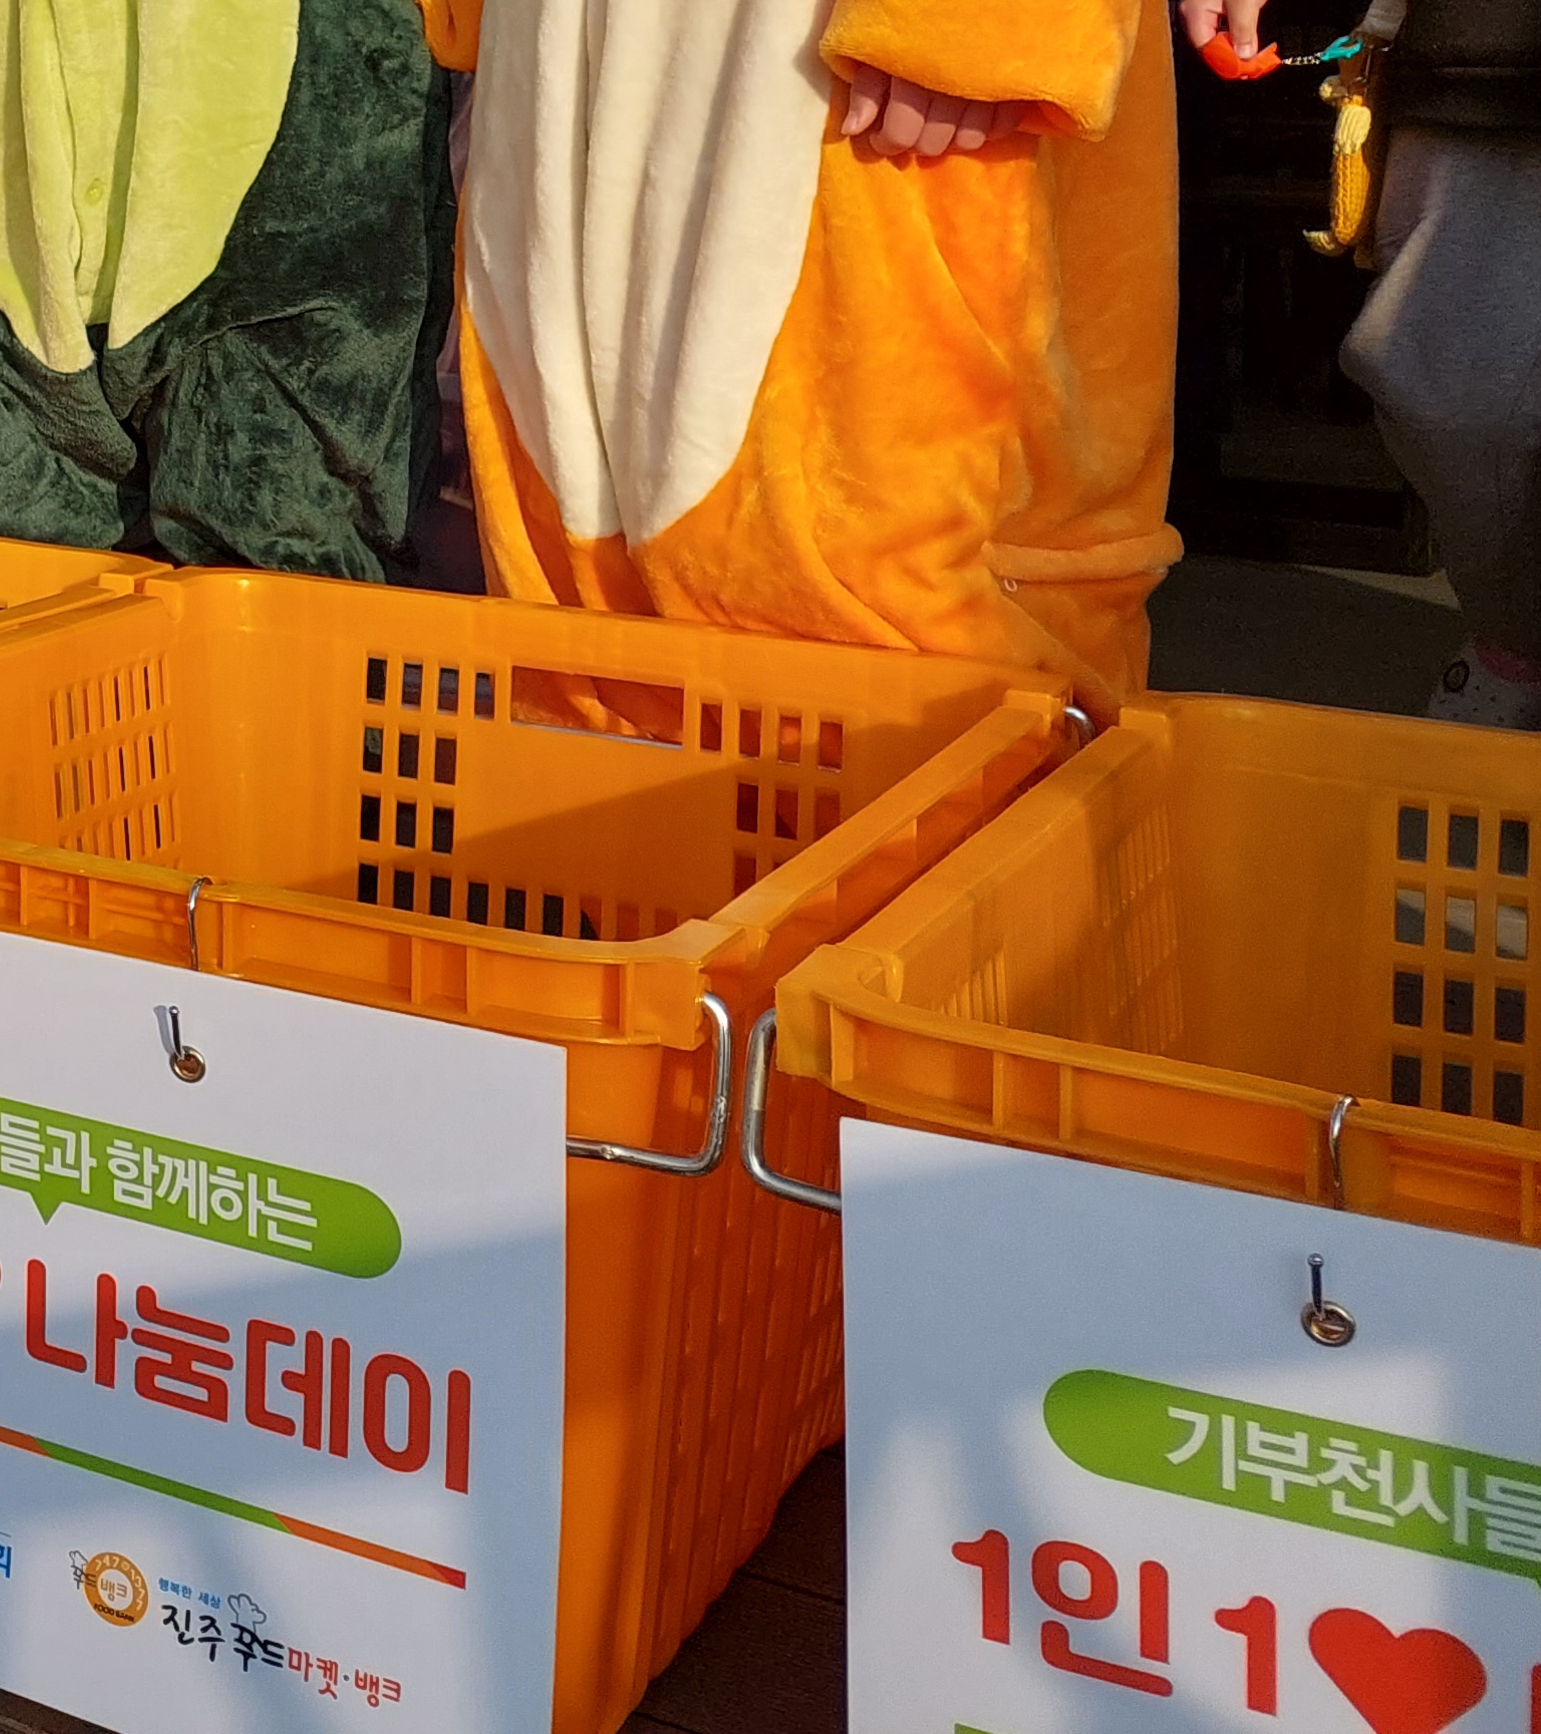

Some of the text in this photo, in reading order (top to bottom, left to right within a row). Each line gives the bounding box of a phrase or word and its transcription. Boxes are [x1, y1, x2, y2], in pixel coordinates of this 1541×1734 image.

[105, 1140, 317, 1251] 함께하는
[25, 1258, 472, 1495] 나눔데이
[100, 1578, 128, 1602] 뱅크
[161, 1604, 226, 1662] 진주
[952, 1529, 1173, 1697] 1인
